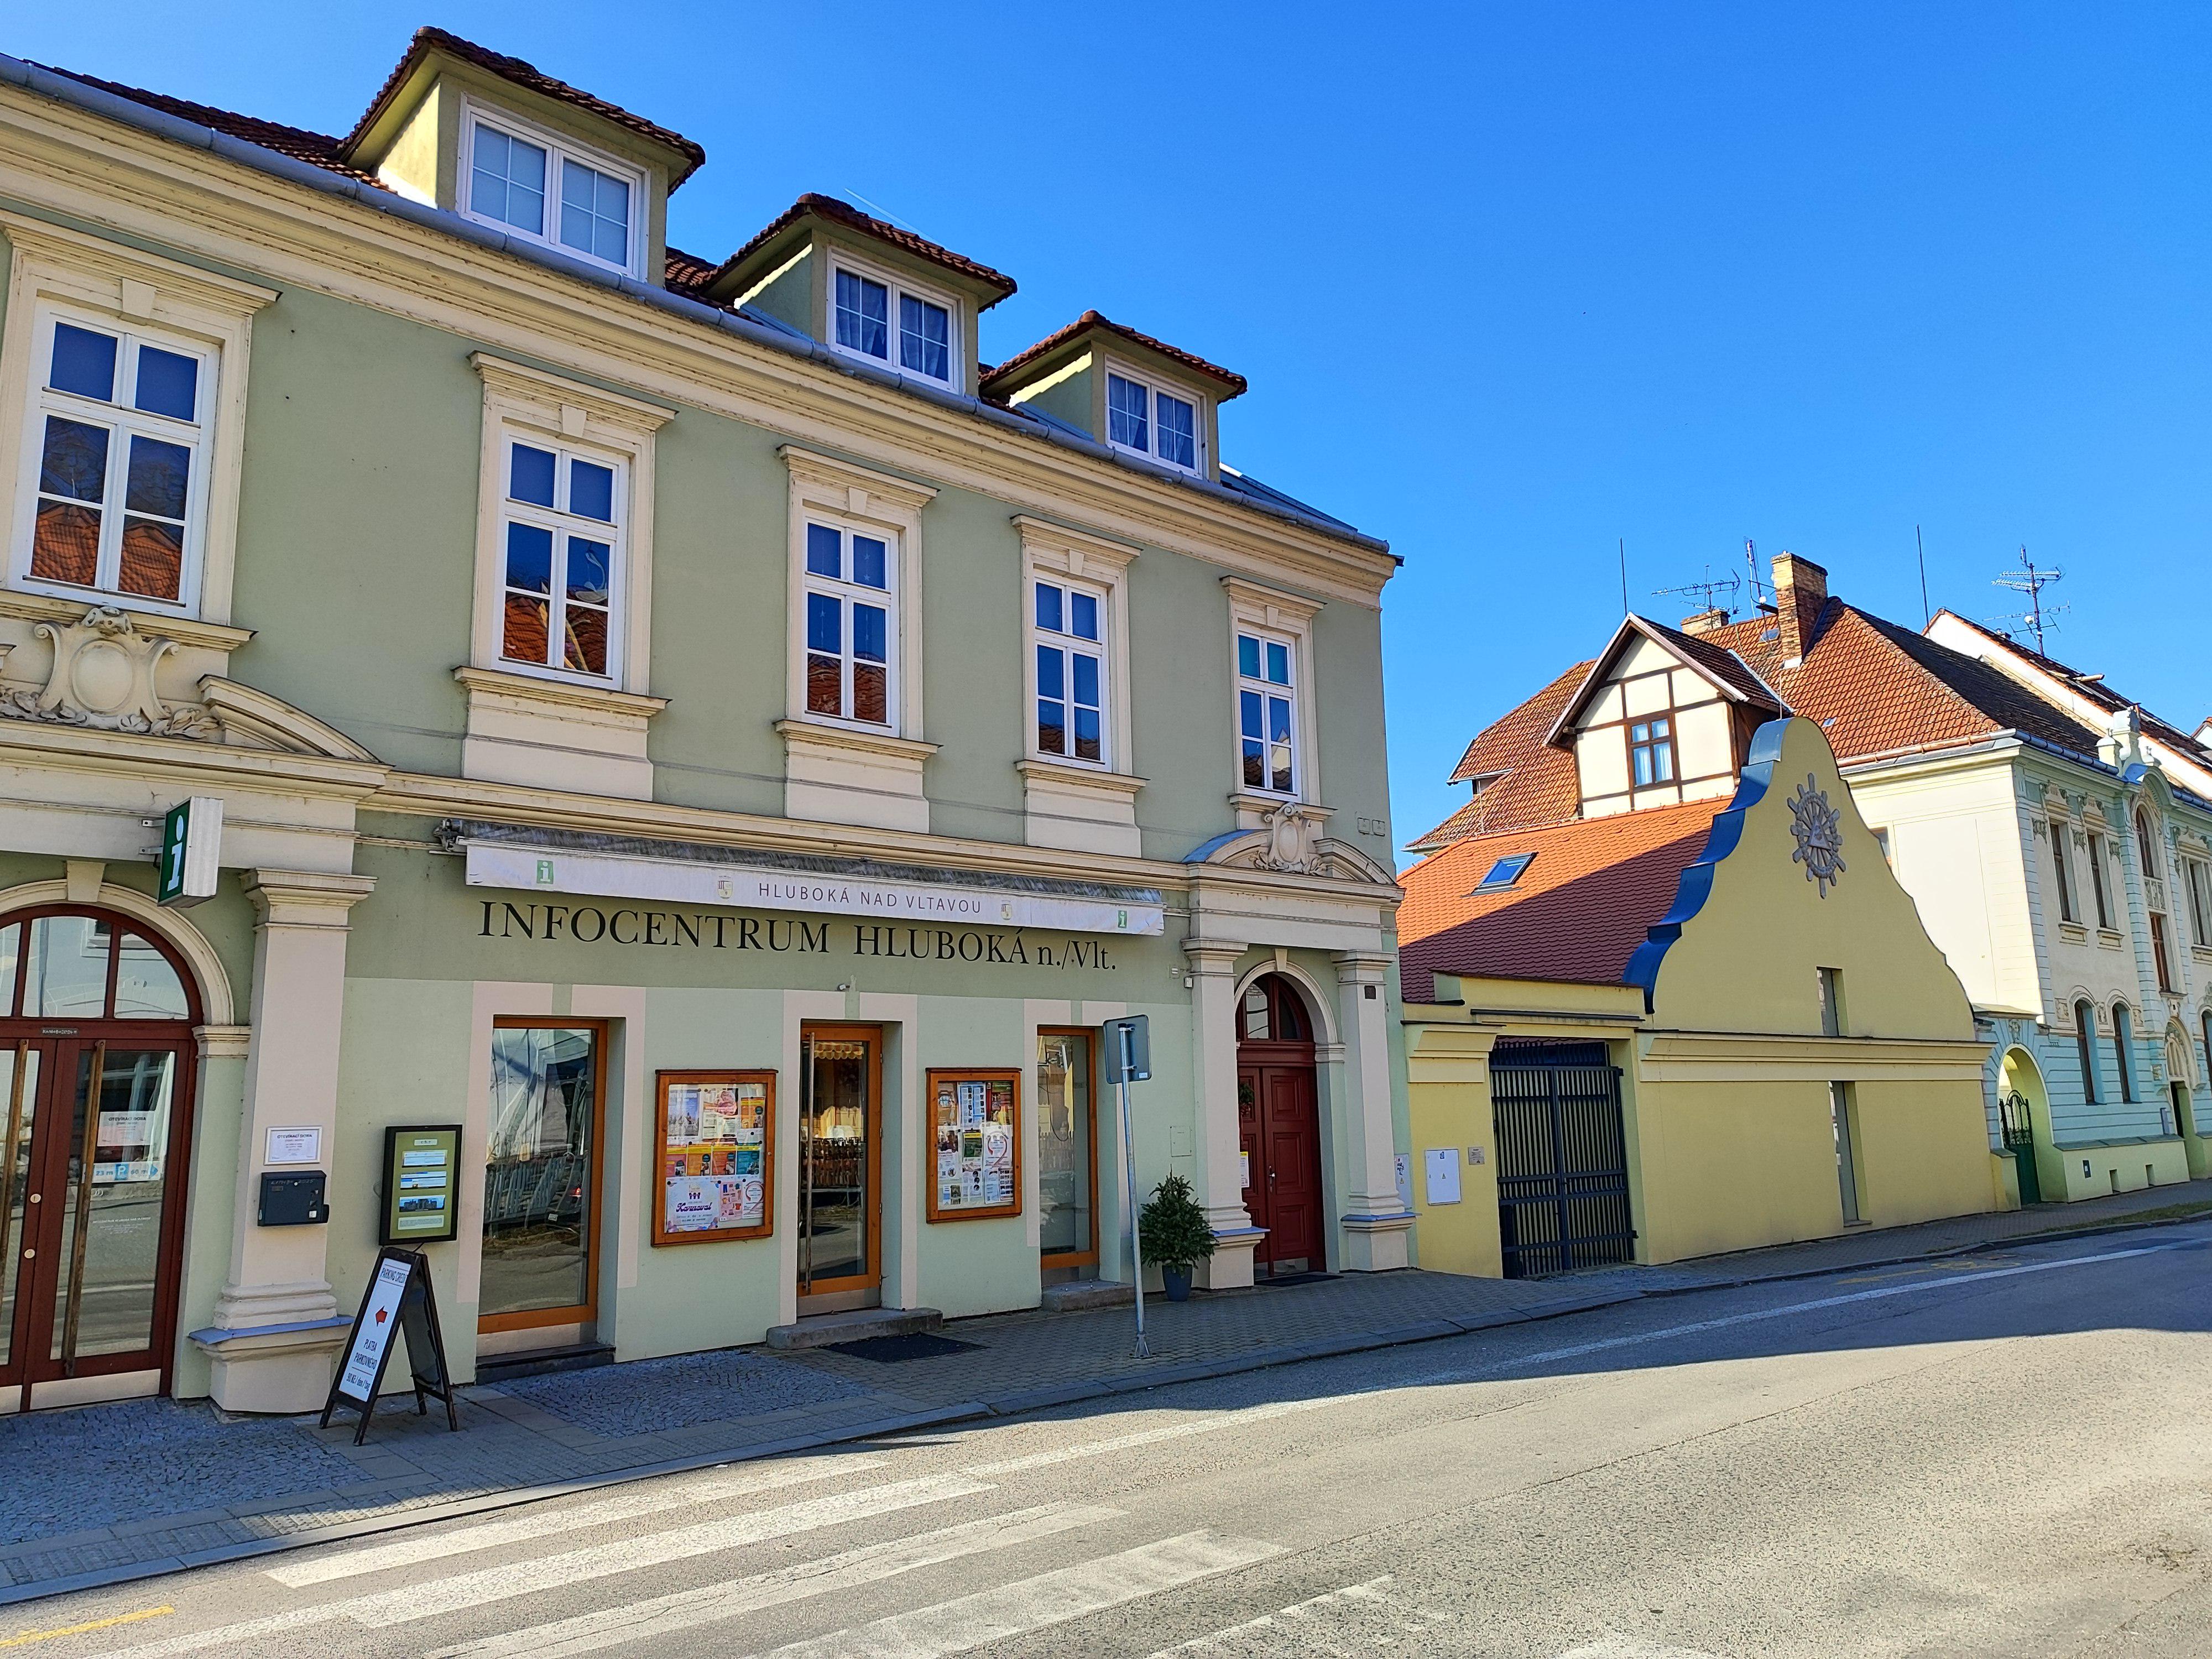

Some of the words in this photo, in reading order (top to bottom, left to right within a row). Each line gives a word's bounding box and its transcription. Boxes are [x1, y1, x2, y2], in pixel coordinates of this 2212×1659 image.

[759, 883, 849, 904] HLUBOKÁ
[860, 891, 897, 907] NAD
[906, 895, 981, 914] VLTAVOU
[477, 900, 831, 953] INFOCENTRUM
[853, 925, 1030, 965] HLUBOKÁ
[118, 1165, 126, 1176] P
